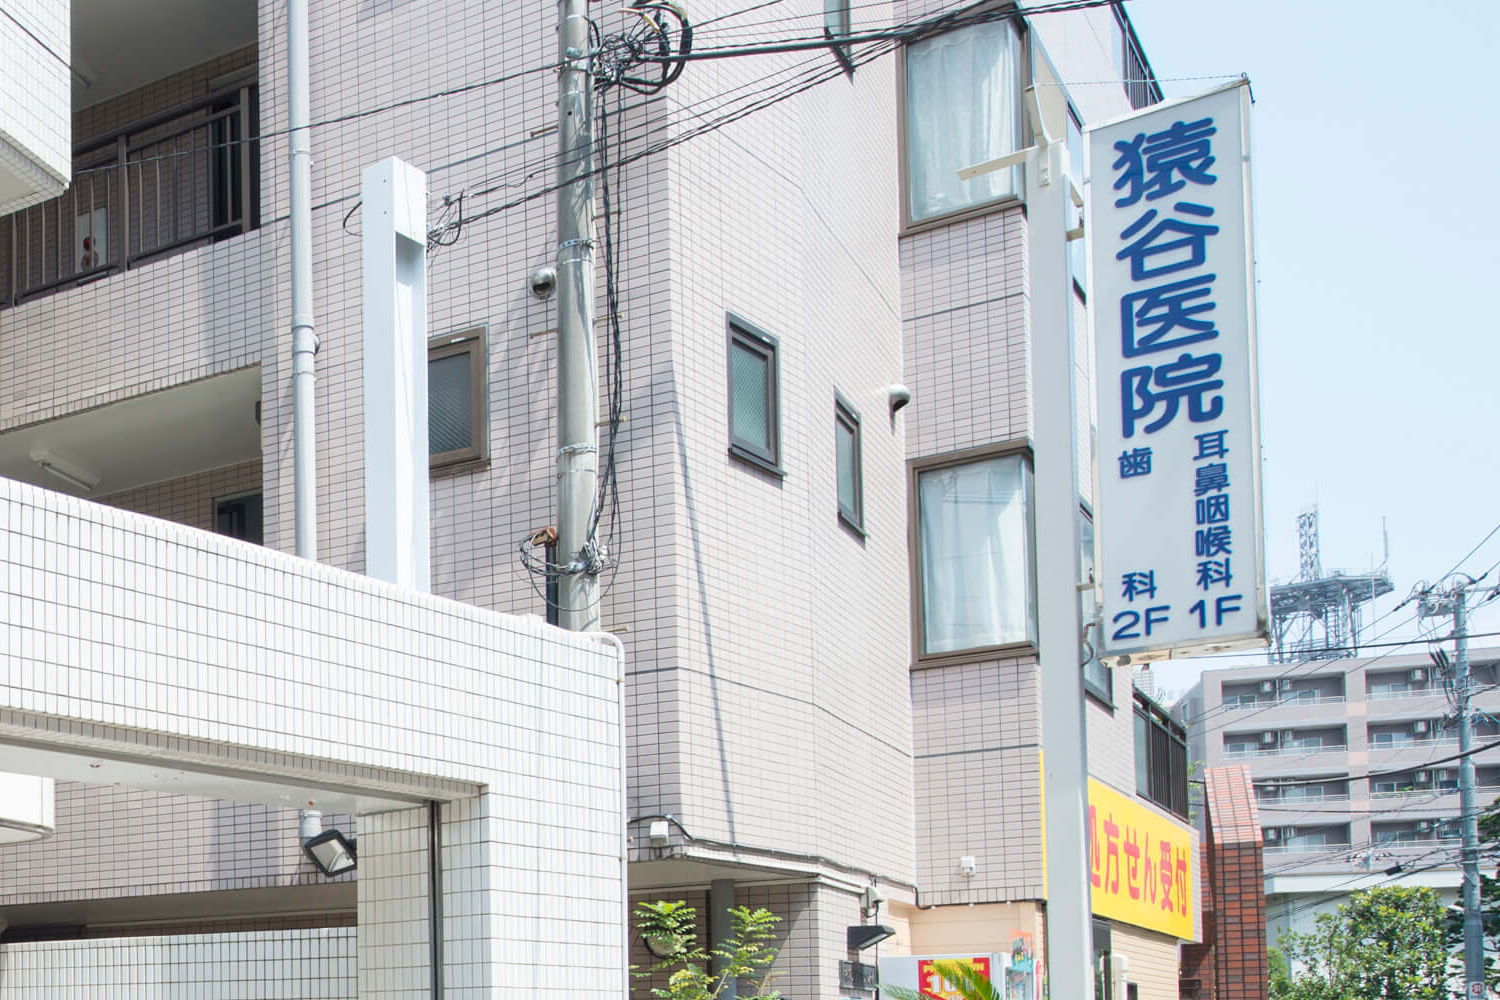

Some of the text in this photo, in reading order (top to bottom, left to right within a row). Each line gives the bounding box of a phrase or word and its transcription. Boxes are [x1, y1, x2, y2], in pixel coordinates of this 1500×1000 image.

[1113, 117, 1225, 439] 猿谷医院
[1193, 430, 1232, 591] 耳鼻咽喉科
[1112, 604, 1171, 641] 2F
[1188, 594, 1242, 628] 1F
